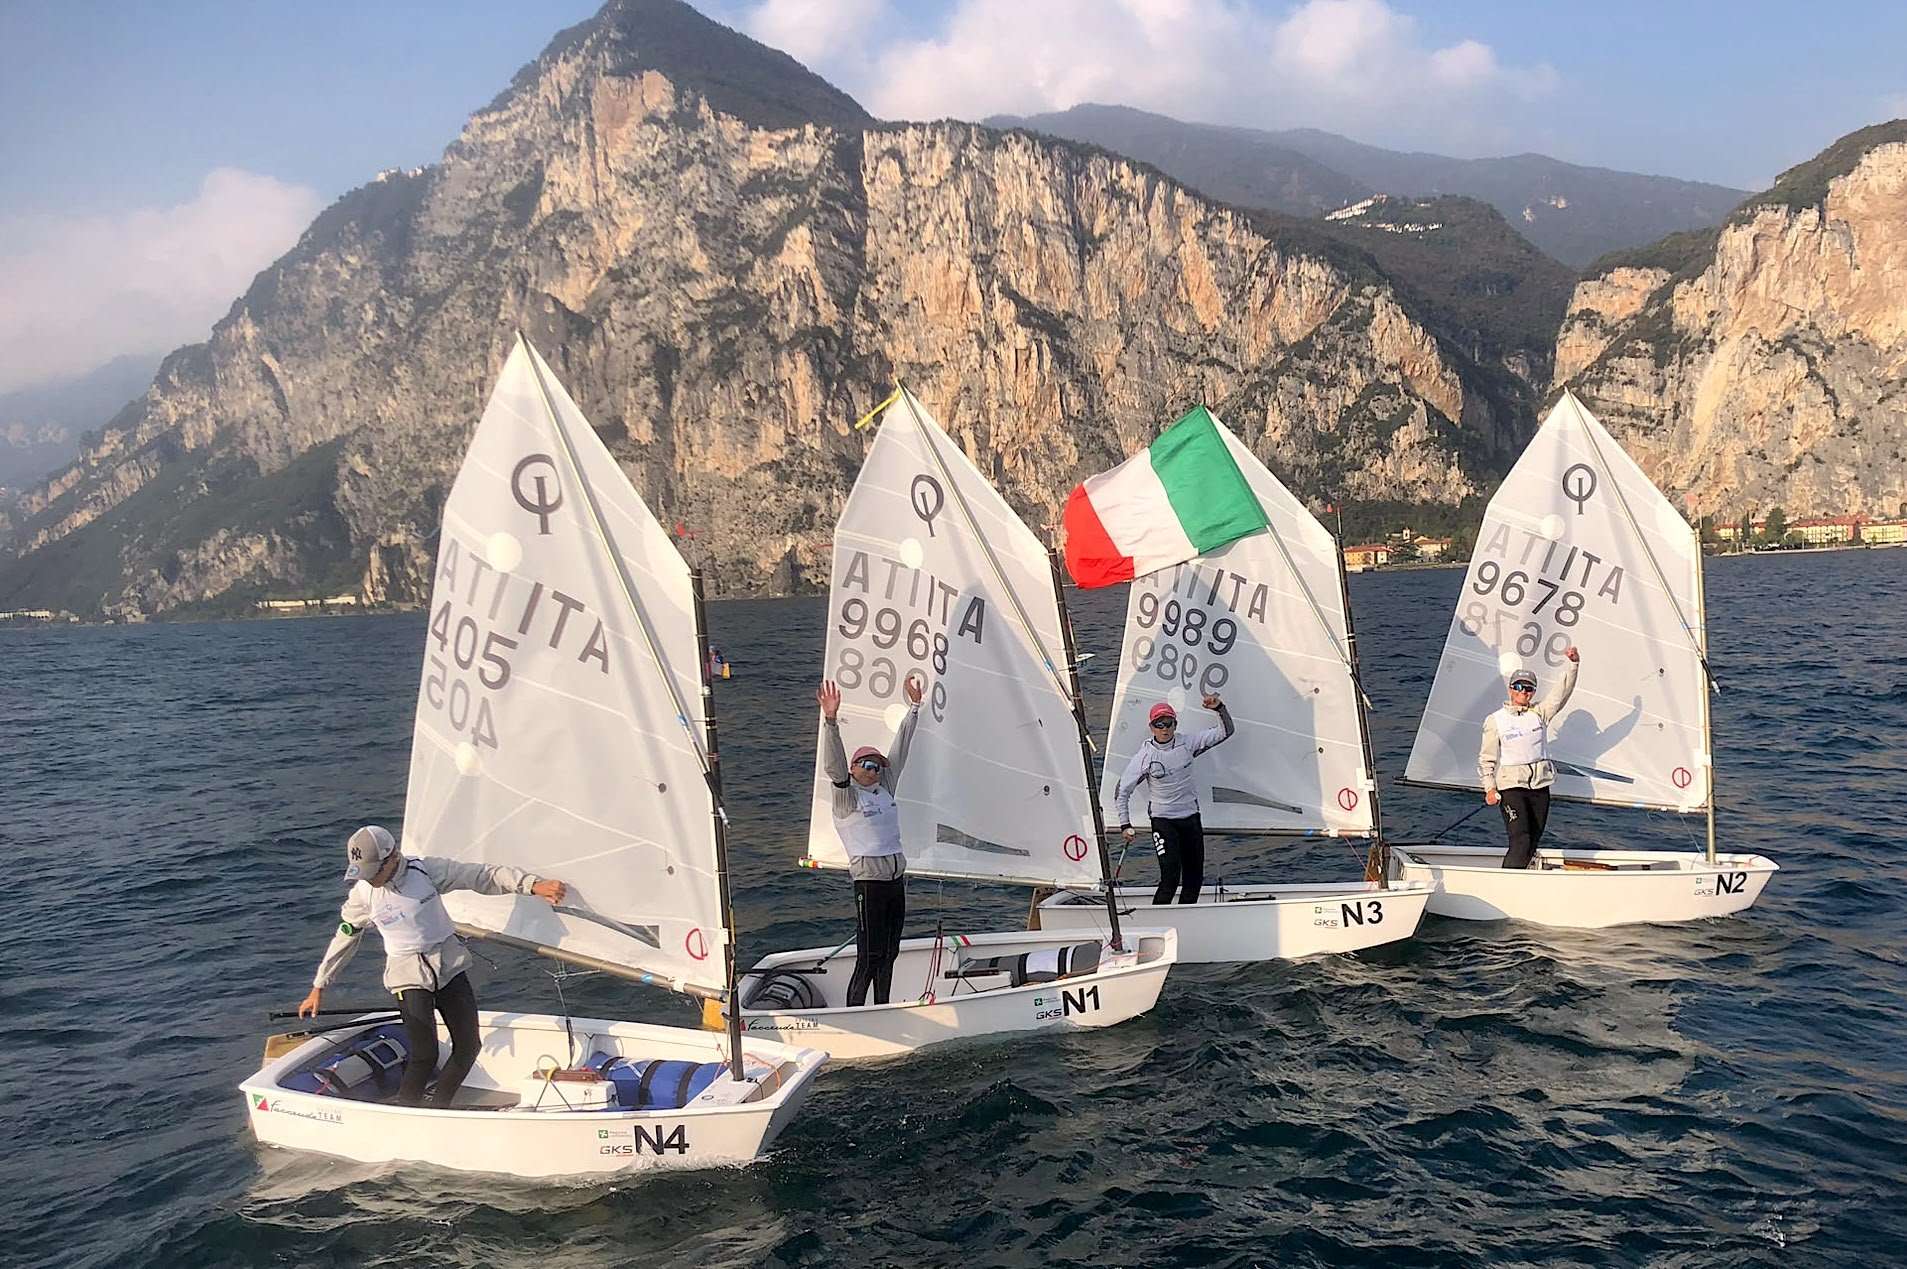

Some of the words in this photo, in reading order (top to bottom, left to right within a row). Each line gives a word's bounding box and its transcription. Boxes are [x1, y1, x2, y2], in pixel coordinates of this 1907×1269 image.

[1559, 546, 1624, 604] ITA
[928, 575, 986, 644] ITA
[1207, 568, 1269, 624] ITA
[1473, 561, 1585, 627] 9678
[518, 582, 609, 674] ITA
[838, 598, 949, 676] 9968
[1136, 592, 1237, 655] 9989
[431, 600, 518, 690] 405
[1715, 872, 1747, 896] N2
[1314, 919, 1338, 927] GKS
[1341, 901, 1384, 927] N3
[1036, 1008, 1062, 1019] GKS
[1062, 985, 1100, 1016] N1
[796, 1022, 818, 1030] TEAM
[318, 1112, 342, 1121] TEAM
[600, 1145, 633, 1155] GKS
[634, 1125, 690, 1155] N4
